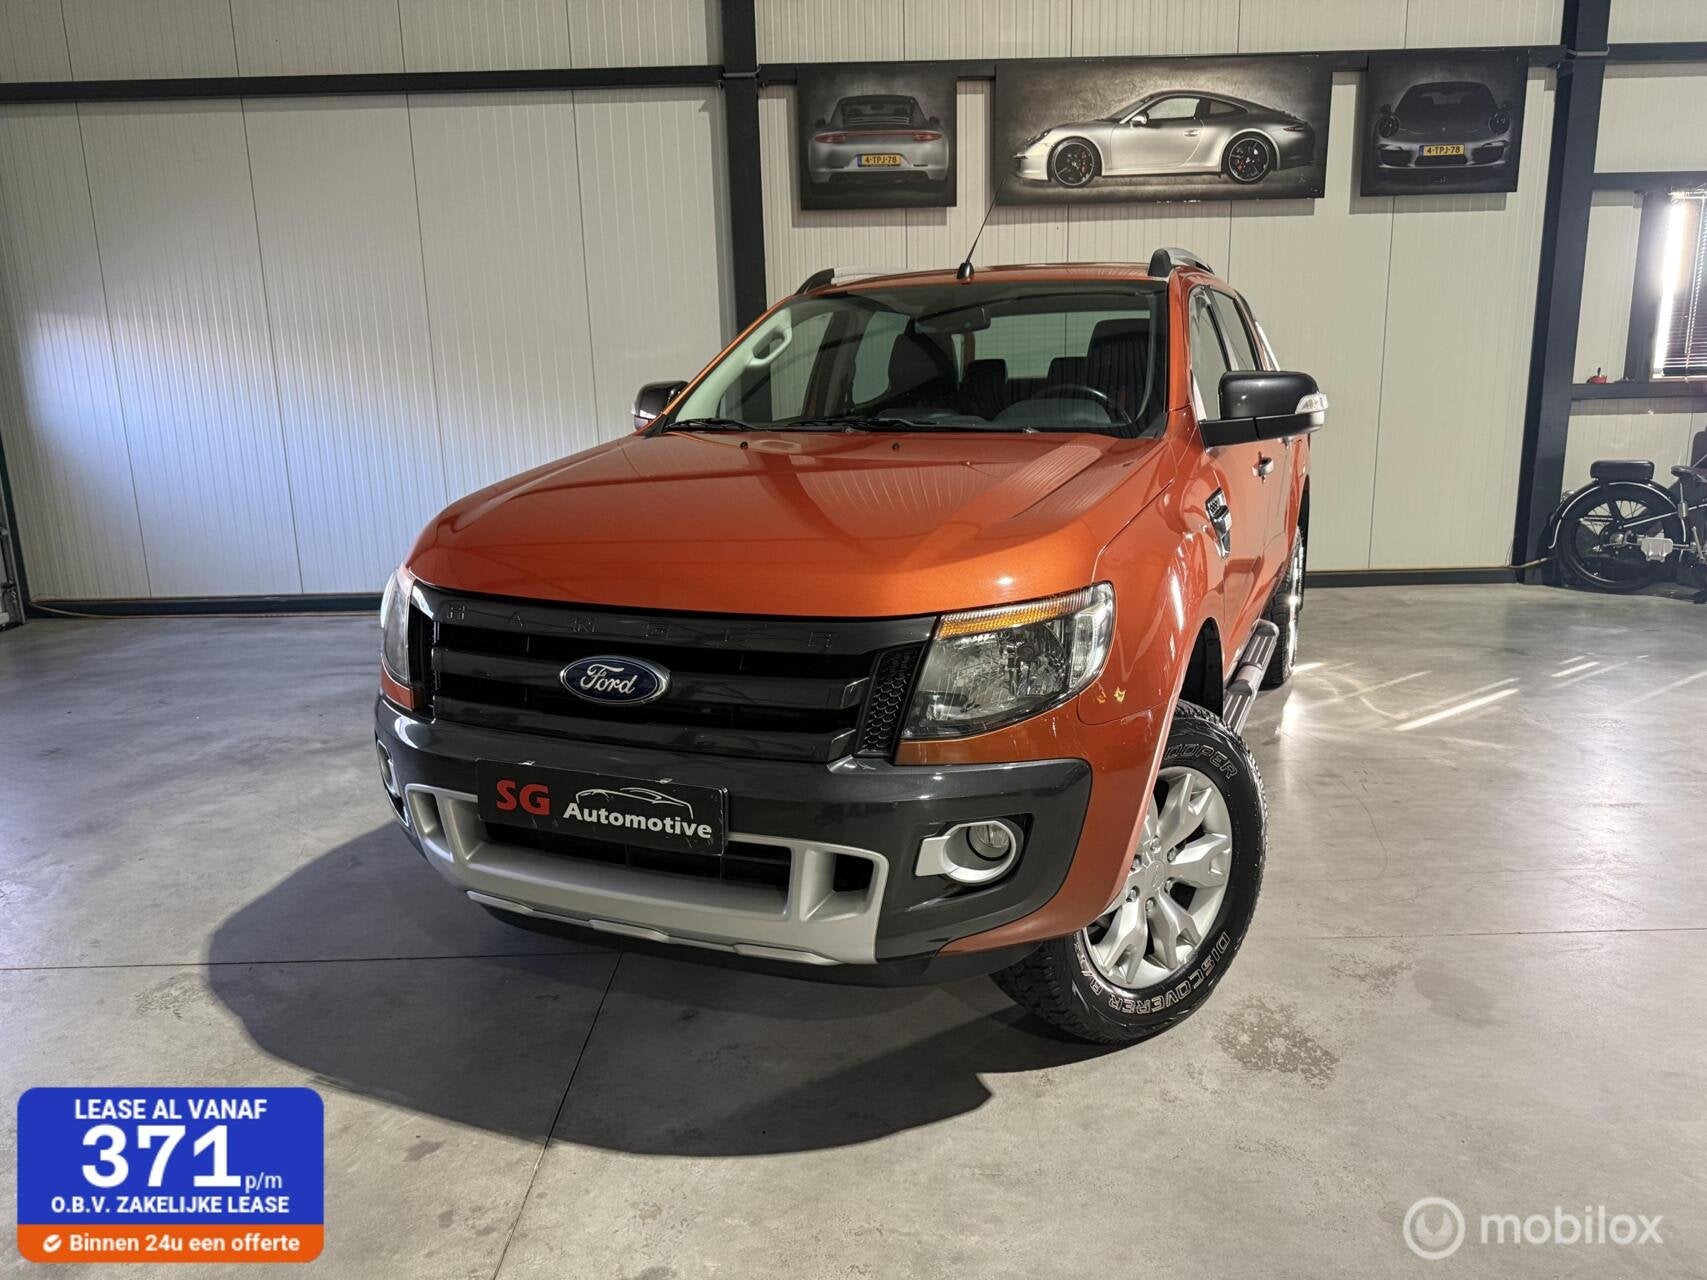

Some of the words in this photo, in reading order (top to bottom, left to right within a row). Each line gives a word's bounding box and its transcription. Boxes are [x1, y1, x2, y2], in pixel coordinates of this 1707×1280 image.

[580, 663, 638, 694] Ford
[496, 779, 550, 816] SG
[563, 802, 712, 839] Automotive
[1108, 931, 1230, 1014] DISCOVERER
